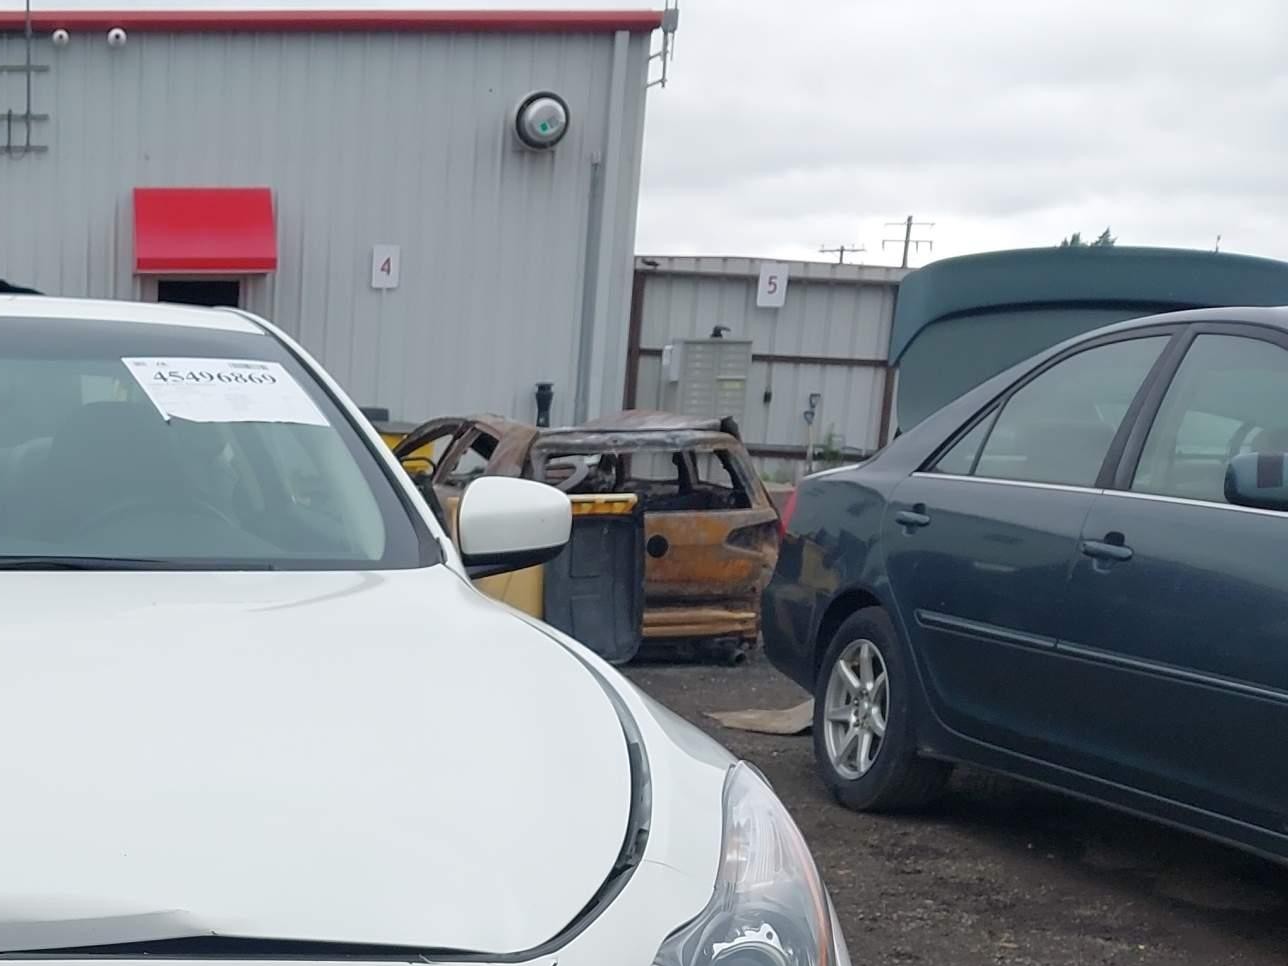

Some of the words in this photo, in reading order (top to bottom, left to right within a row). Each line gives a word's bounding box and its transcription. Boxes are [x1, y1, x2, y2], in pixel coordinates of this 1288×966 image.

[380, 256, 391, 276] 4
[767, 275, 778, 295] 5
[153, 370, 277, 384] 45496869
